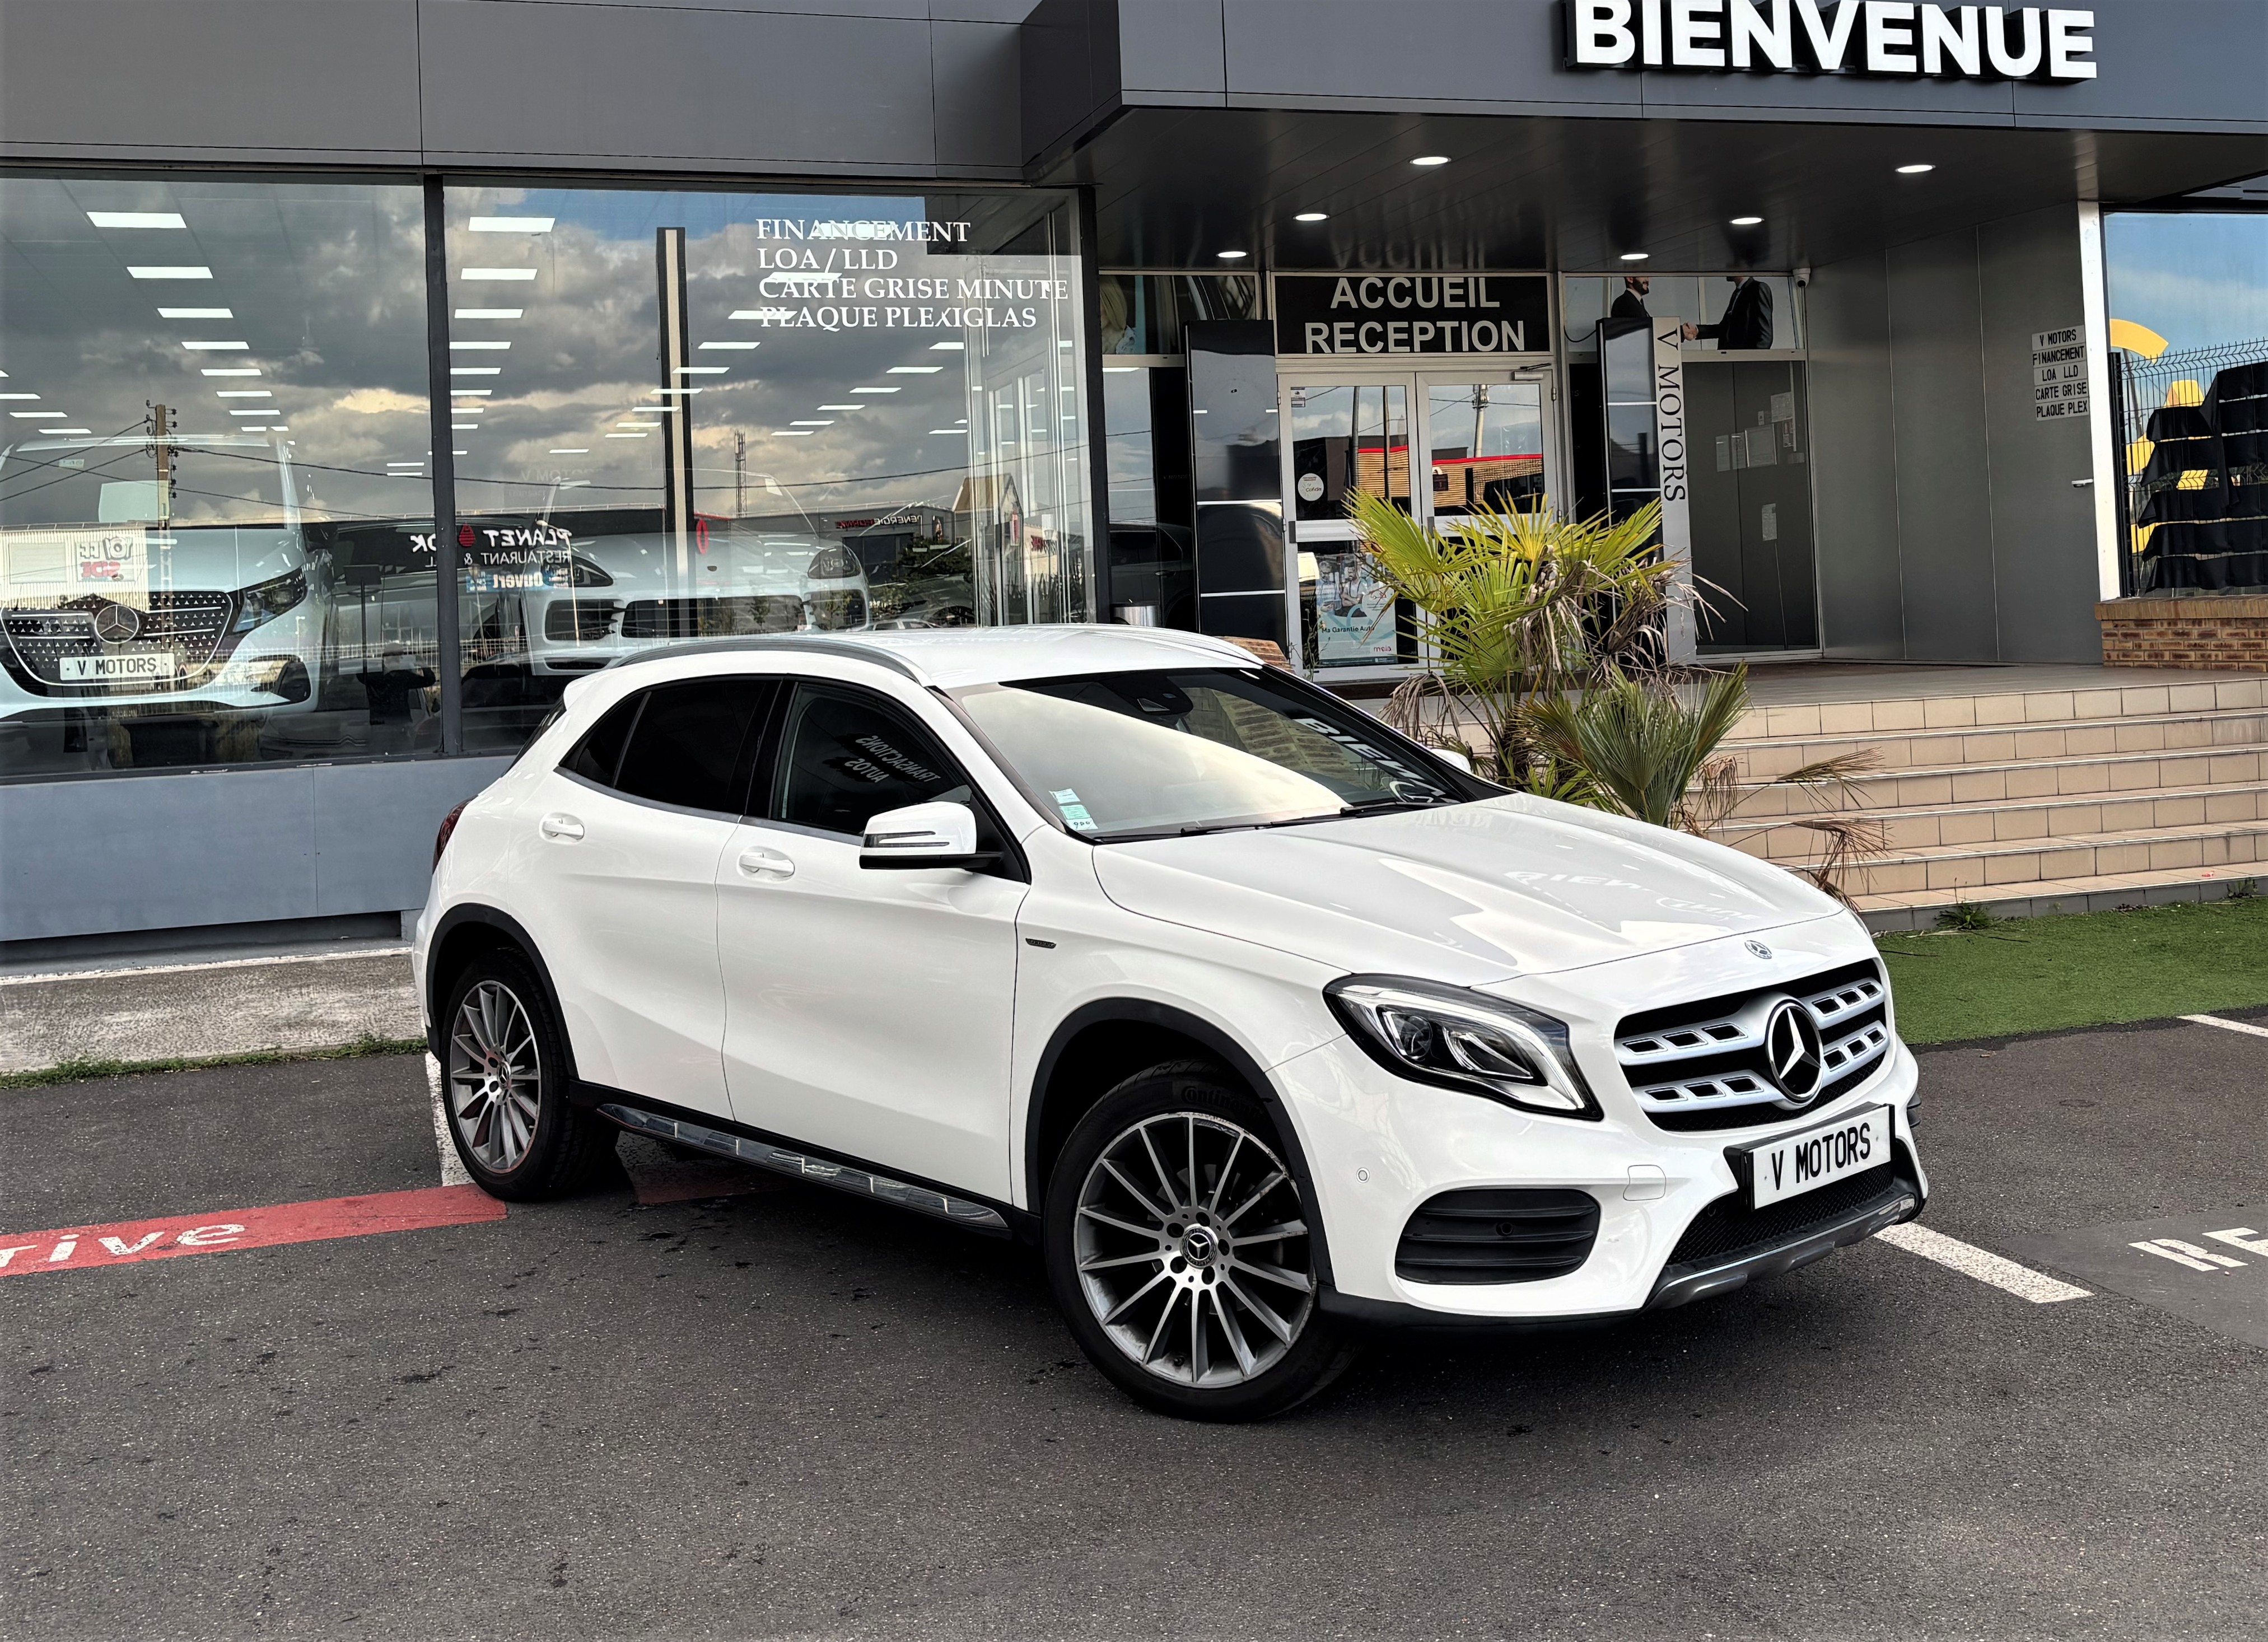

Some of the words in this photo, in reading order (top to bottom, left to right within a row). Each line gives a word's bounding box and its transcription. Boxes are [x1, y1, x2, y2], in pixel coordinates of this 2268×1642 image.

[1574, 0, 2097, 78] BIENVENUE
[756, 218, 970, 242] FINANCEMENT
[759, 278, 856, 298] CARTE
[864, 278, 950, 299] GRISE
[957, 279, 1068, 300] MINUTE
[1331, 277, 1500, 310] ACCUEIL
[760, 306, 878, 332] PLAQUE
[885, 307, 1037, 328] PLEXIGLAS
[1305, 320, 1525, 354] RECEPTION
[1656, 329, 1679, 351] V
[2040, 334, 2045, 347] V
[2047, 329, 2076, 346] MOTORS
[2033, 346, 2084, 366] FINANCEMENT
[2042, 368, 2056, 382] LOA
[2064, 365, 2078, 379] LLD
[2036, 386, 2059, 400] CARTE
[2062, 382, 2087, 396] GRISE
[2036, 403, 2065, 418] PLAQUE
[2068, 400, 2088, 414] PLEX
[1658, 363, 1686, 502] MOTORS
[77, 660, 87, 675] V
[95, 657, 157, 675] MOTORS
[1771, 1150, 1784, 1191] V
[1795, 1122, 1871, 1184] MOTORS
